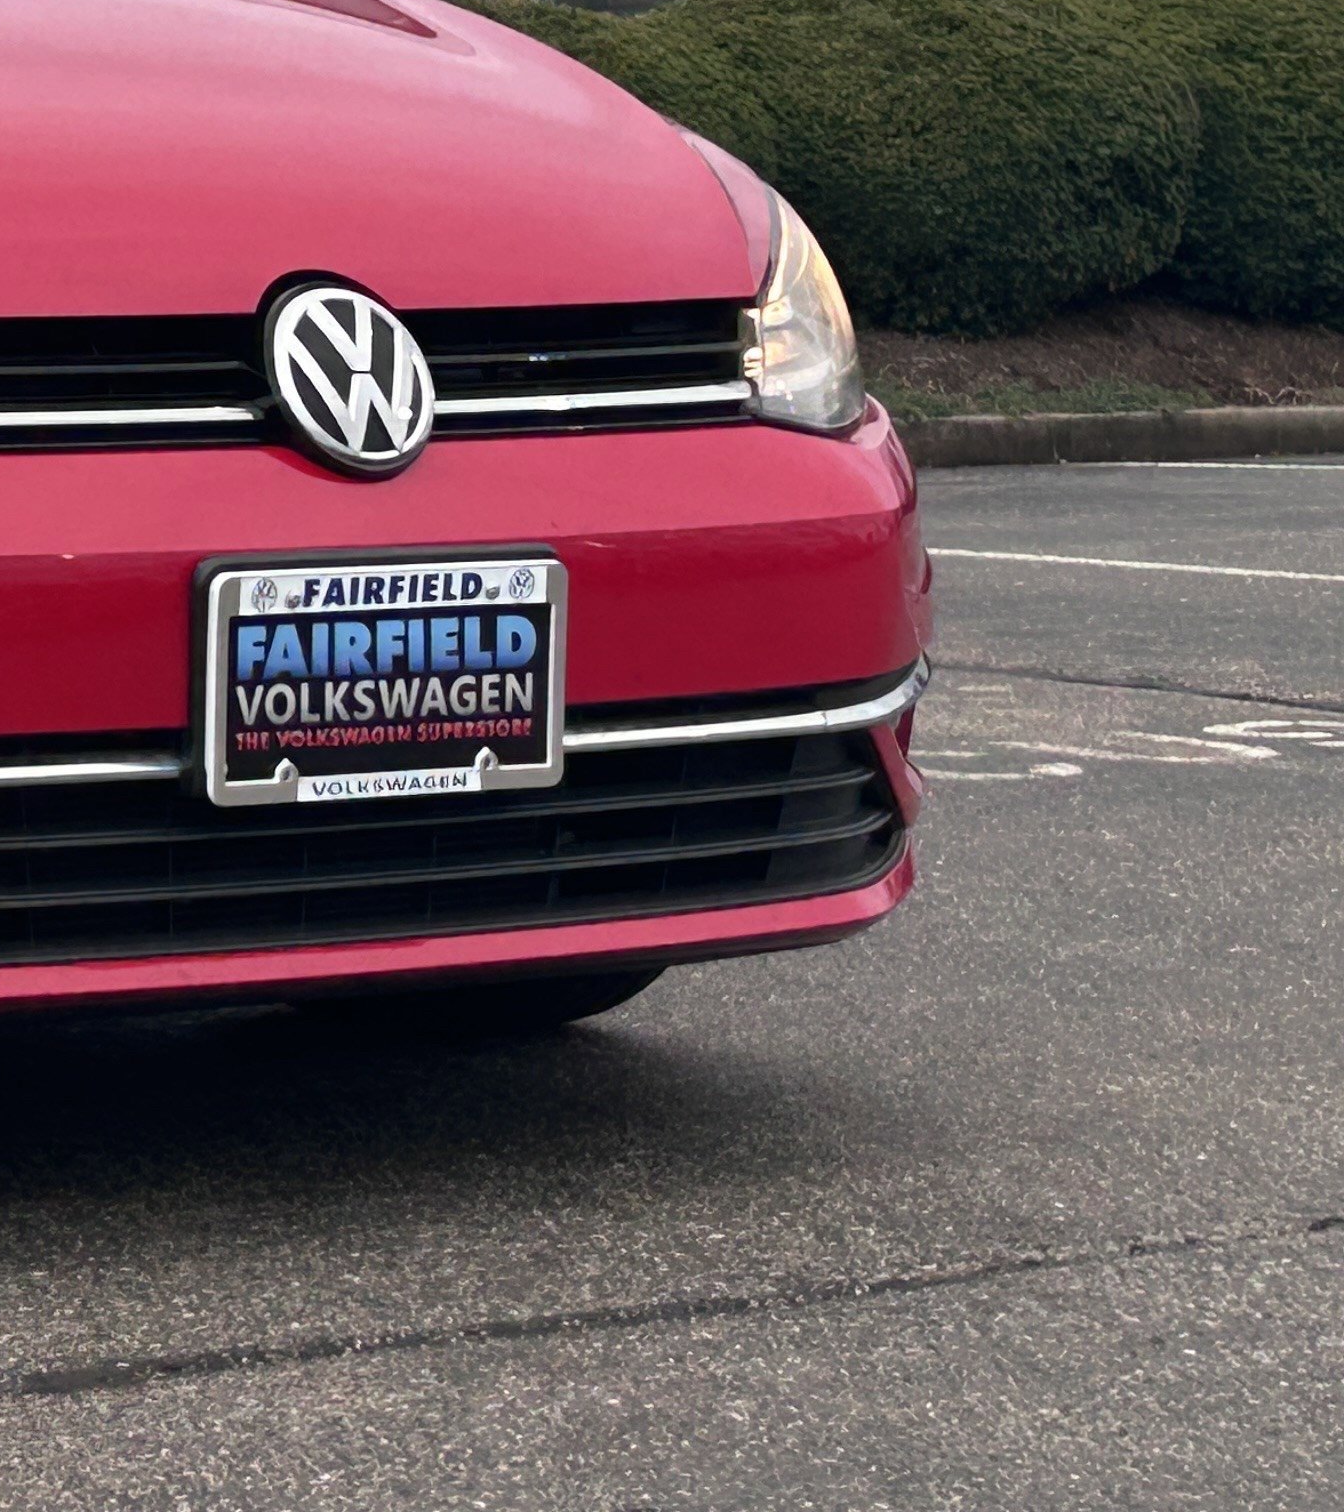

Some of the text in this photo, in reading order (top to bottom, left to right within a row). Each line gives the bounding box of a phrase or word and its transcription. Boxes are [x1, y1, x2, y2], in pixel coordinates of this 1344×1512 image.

[301, 571, 485, 608] FAIRFIELD
[235, 614, 539, 682] FAIRFIELD
[234, 672, 535, 727] VOLKSWAGEN
